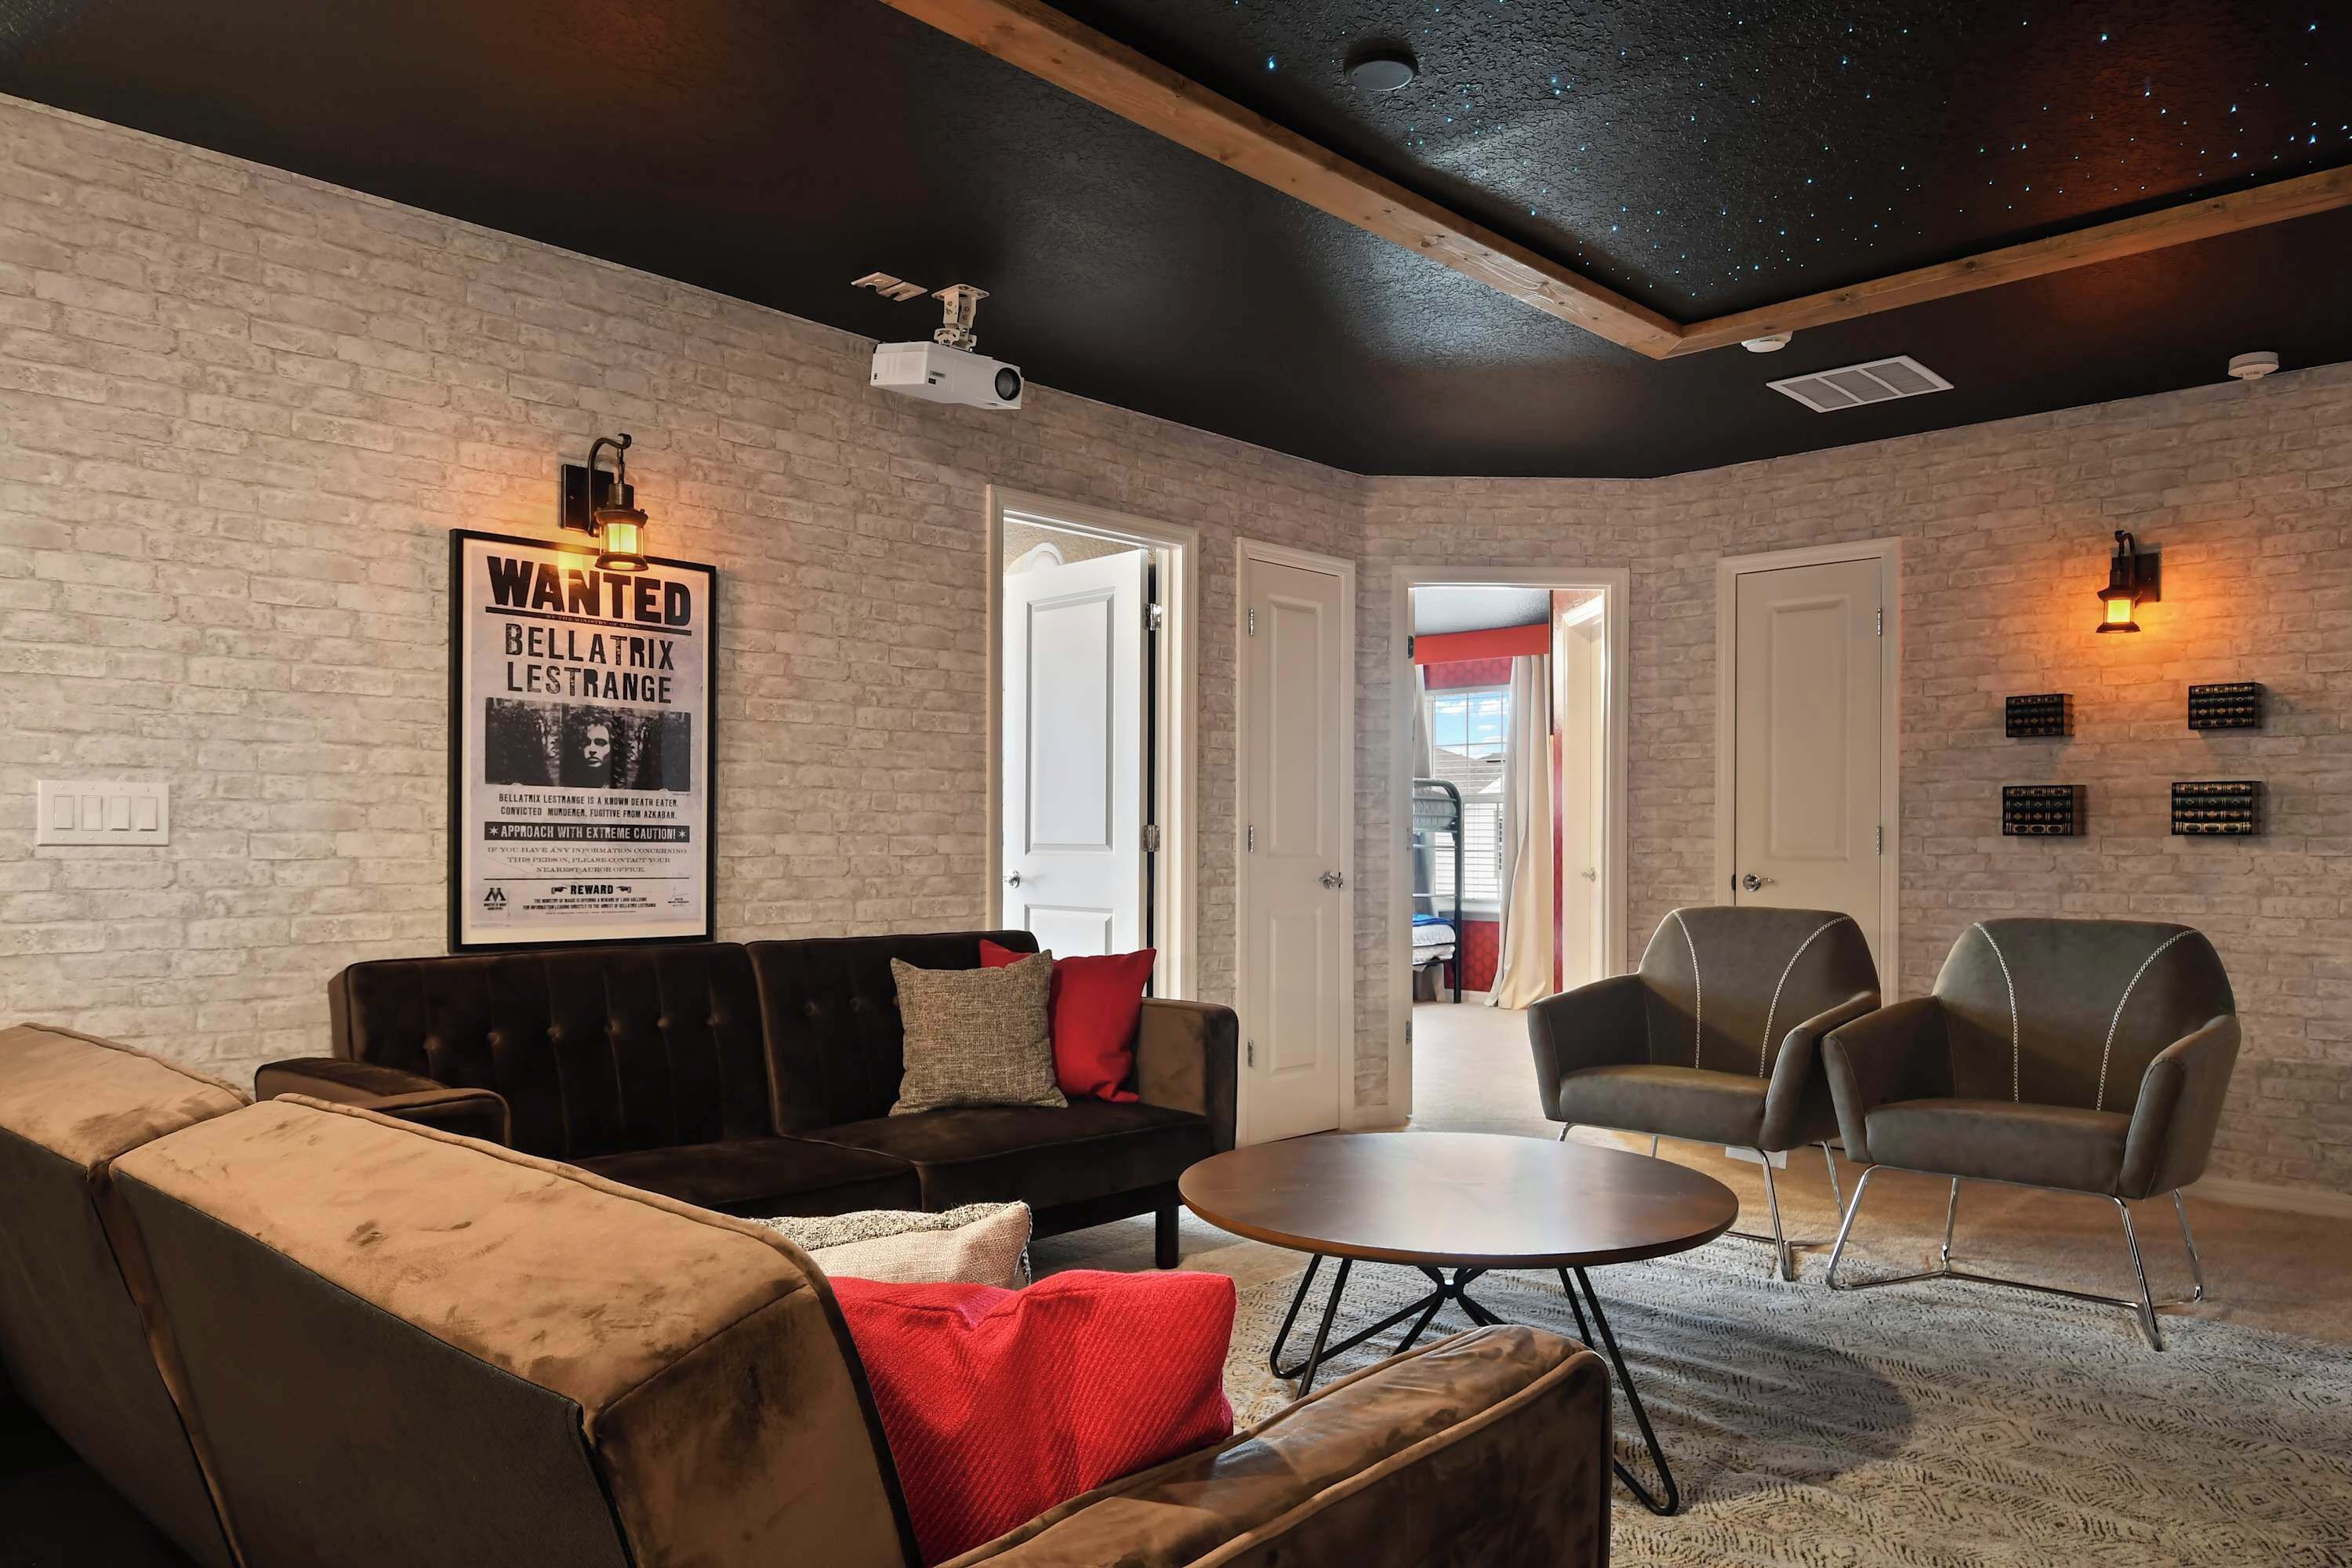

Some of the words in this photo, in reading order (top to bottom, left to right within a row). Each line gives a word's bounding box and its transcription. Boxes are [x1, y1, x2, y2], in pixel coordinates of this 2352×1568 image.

[487, 556, 691, 626] WANTED
[506, 623, 674, 670] BELLATRIX
[507, 662, 672, 704] LESTRANGE
[499, 793, 540, 803] BELLATRIX
[544, 795, 584, 804] LESTRANGE
[588, 796, 594, 804] IS
[604, 797, 629, 806] KNOWN
[631, 798, 653, 806] DEATH
[501, 806, 542, 815] CONVICTED
[590, 809, 620, 818] FUGITIVE
[501, 825, 554, 838] APPROACH
[557, 826, 583, 838] WITH
[586, 827, 630, 839] EXTREME
[634, 828, 675, 840] CAUTION!
[571, 885, 613, 894] REWARD
